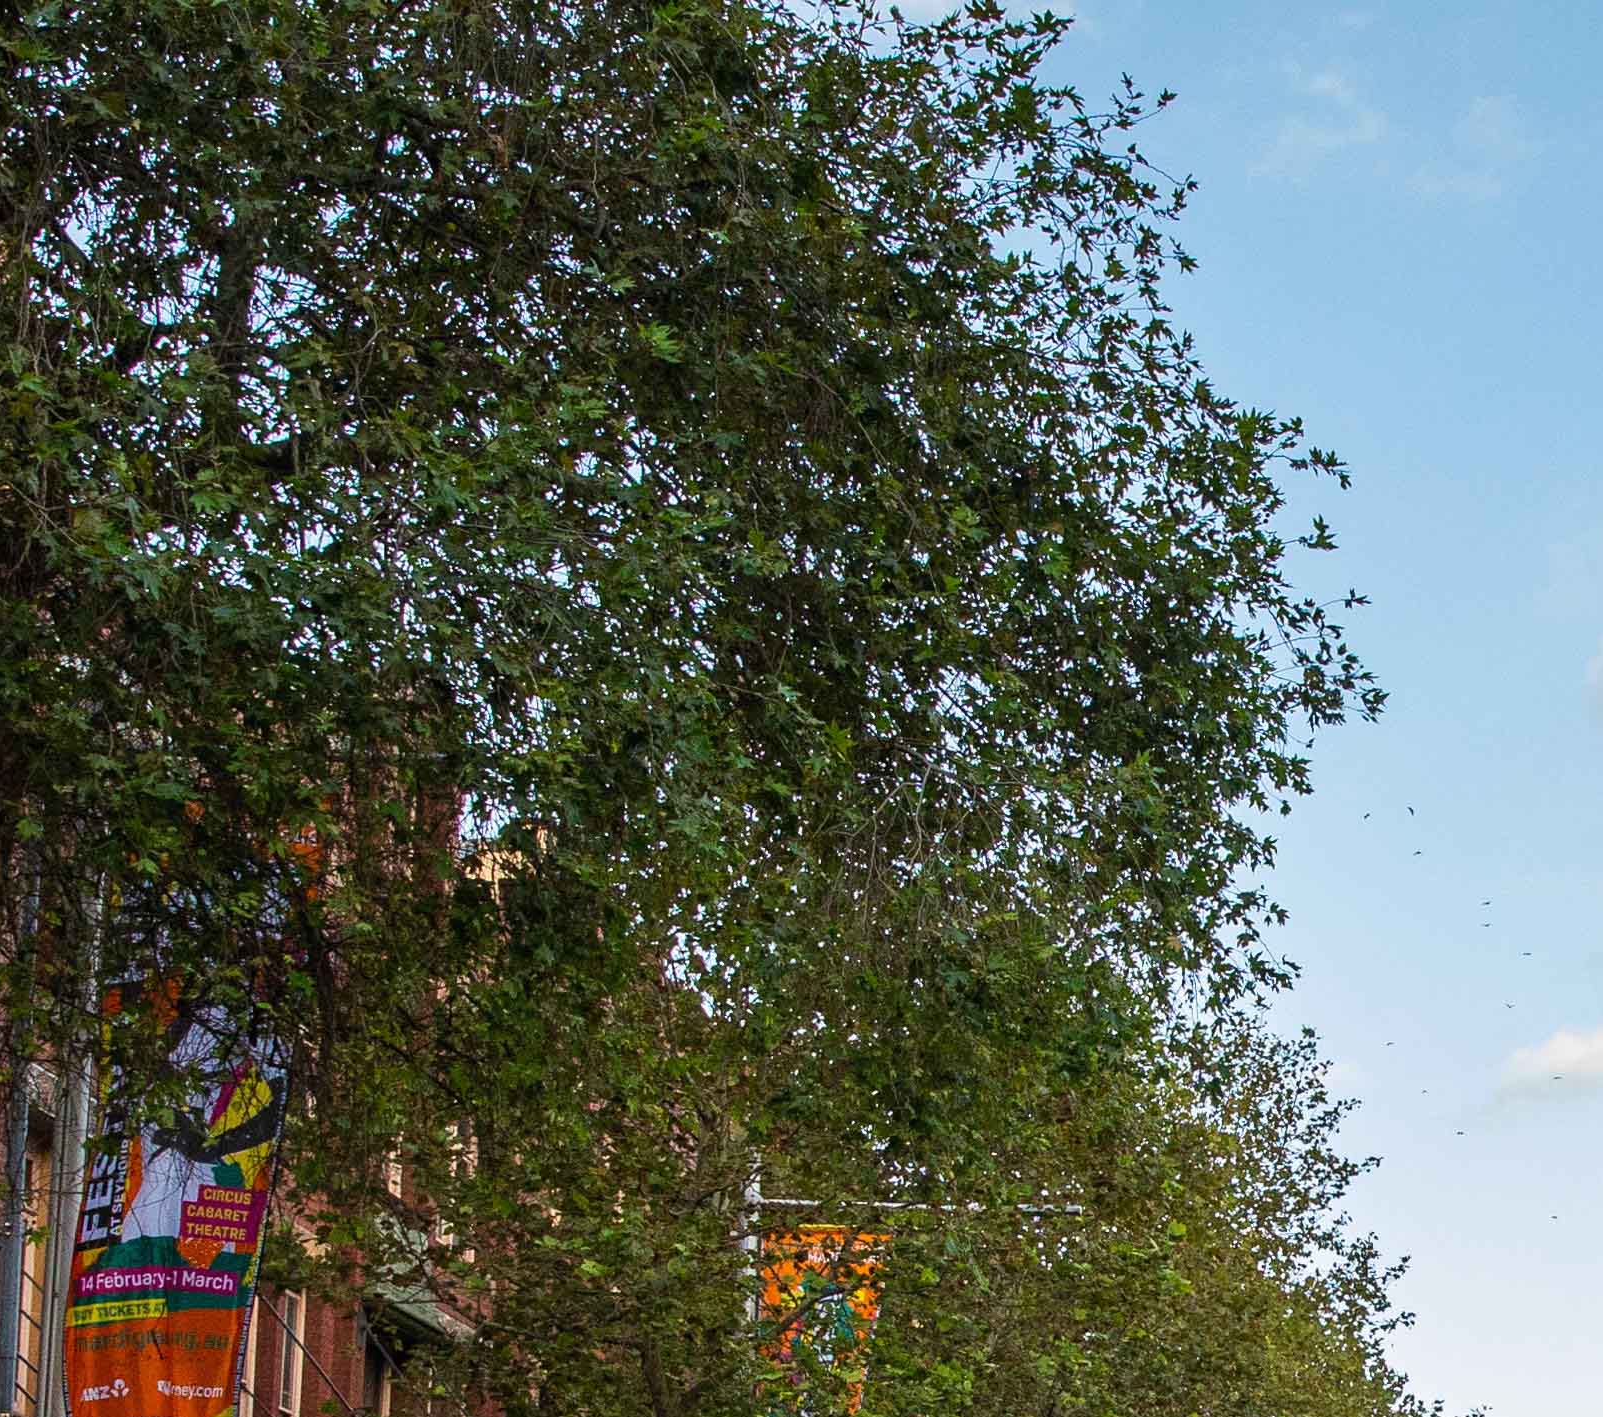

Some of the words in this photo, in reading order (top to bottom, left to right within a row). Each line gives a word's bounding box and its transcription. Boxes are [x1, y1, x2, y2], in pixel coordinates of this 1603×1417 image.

[203, 1188, 252, 1205] CIRCUS
[186, 1204, 250, 1222] CABARET
[186, 1222, 247, 1241] THEATRE
[181, 1270, 234, 1291] March
[98, 1304, 150, 1319] TICKETS
